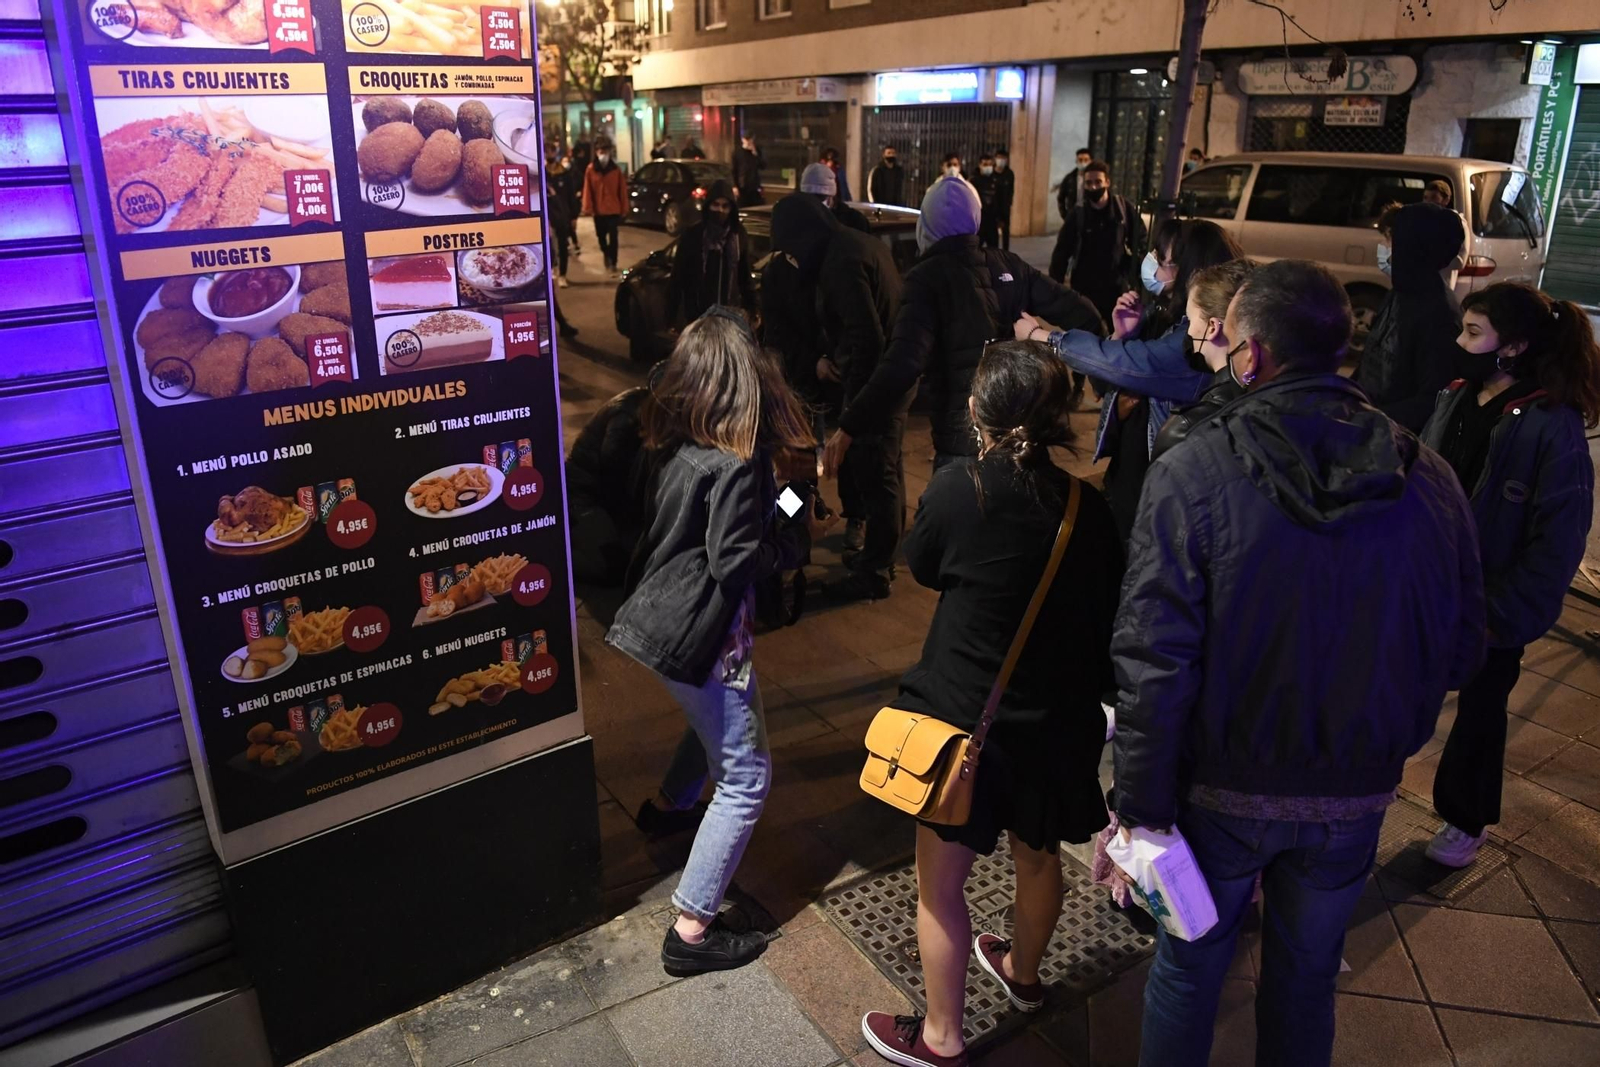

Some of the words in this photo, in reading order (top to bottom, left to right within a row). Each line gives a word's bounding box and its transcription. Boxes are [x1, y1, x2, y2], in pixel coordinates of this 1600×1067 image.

[95, 4, 127, 18] 100%
[96, 15, 132, 28] CASERO
[356, 14, 382, 26] 100%
[488, 15, 515, 30] 3,50€
[275, 27, 309, 43] 4,50€
[356, 24, 385, 35] CASERO
[489, 36, 516, 51] 2,50€
[1540, 46, 1554, 61] PC
[1532, 60, 1551, 76] BOX
[117, 70, 175, 89] TIRAS
[182, 70, 290, 90] CRUJIENTES
[359, 70, 449, 91] CROQUETAS
[460, 81, 496, 89] COMBINADAS
[495, 75, 524, 83] ESPINACAS
[1532, 111, 1555, 178] PORTÁTILES
[1545, 100, 1557, 109] Y
[293, 181, 325, 195] 7,00€
[498, 174, 524, 187] 6,50€
[372, 184, 398, 196] 100%
[373, 191, 401, 204] CASERO
[125, 192, 156, 207] 100%
[500, 194, 525, 207] 4,00€
[127, 201, 160, 216] CASERO
[296, 203, 328, 217] 4,00€
[423, 231, 485, 250] POSTRES
[190, 246, 272, 268] NUGGETS
[391, 338, 415, 351] 100%
[507, 330, 535, 344] 1,95€
[314, 344, 344, 358] 6,50€
[391, 346, 418, 360] CASERO
[317, 364, 346, 378] 4,00€
[263, 404, 337, 427] MENUS
[340, 380, 467, 415] INDIVIDUALES
[394, 427, 406, 439] 2.
[409, 419, 437, 437] MENÚ
[441, 416, 470, 431] TIRAS
[473, 406, 531, 426] CRUJIENTES
[176, 464, 189, 477] 1.
[191, 455, 227, 475] MENÚ
[231, 450, 269, 468] POLLO
[273, 442, 313, 461] ASADO
[510, 482, 537, 498] 4,95€
[320, 490, 339, 517] Sprite
[336, 517, 369, 535] 4,95€
[408, 547, 420, 558] 4.
[422, 538, 450, 556] MENÚ
[453, 526, 508, 548] CROQUETAS
[511, 522, 522, 535] DE
[525, 515, 556, 531] JAMÓN
[201, 595, 215, 608] 3.
[217, 584, 251, 605] MENÚ
[255, 569, 322, 596] CROQUETAS
[325, 565, 339, 579] DE
[342, 557, 376, 575] POLLO
[519, 578, 545, 594] 4,95€
[352, 622, 382, 639] 4,95€
[422, 649, 433, 660] 6.
[435, 638, 462, 657] MENÚ
[464, 627, 507, 648] NUGGETS
[527, 667, 552, 683] 4,95€
[222, 706, 235, 719] 5.
[237, 693, 270, 714] MENÚ
[273, 676, 337, 703] CROQUETAS
[340, 671, 354, 686] DE
[357, 654, 413, 679] ESPINACAS
[366, 717, 395, 734] 4,95€
[306, 774, 354, 796] PRODUCTOS
[355, 767, 375, 779] 100%
[377, 750, 426, 772] ELABORADOS
[427, 745, 437, 755] EN
[438, 741, 455, 751] ESTE
[456, 718, 517, 744] ESTABLECIMIENTO
[968, 909, 1006, 942] ndes
